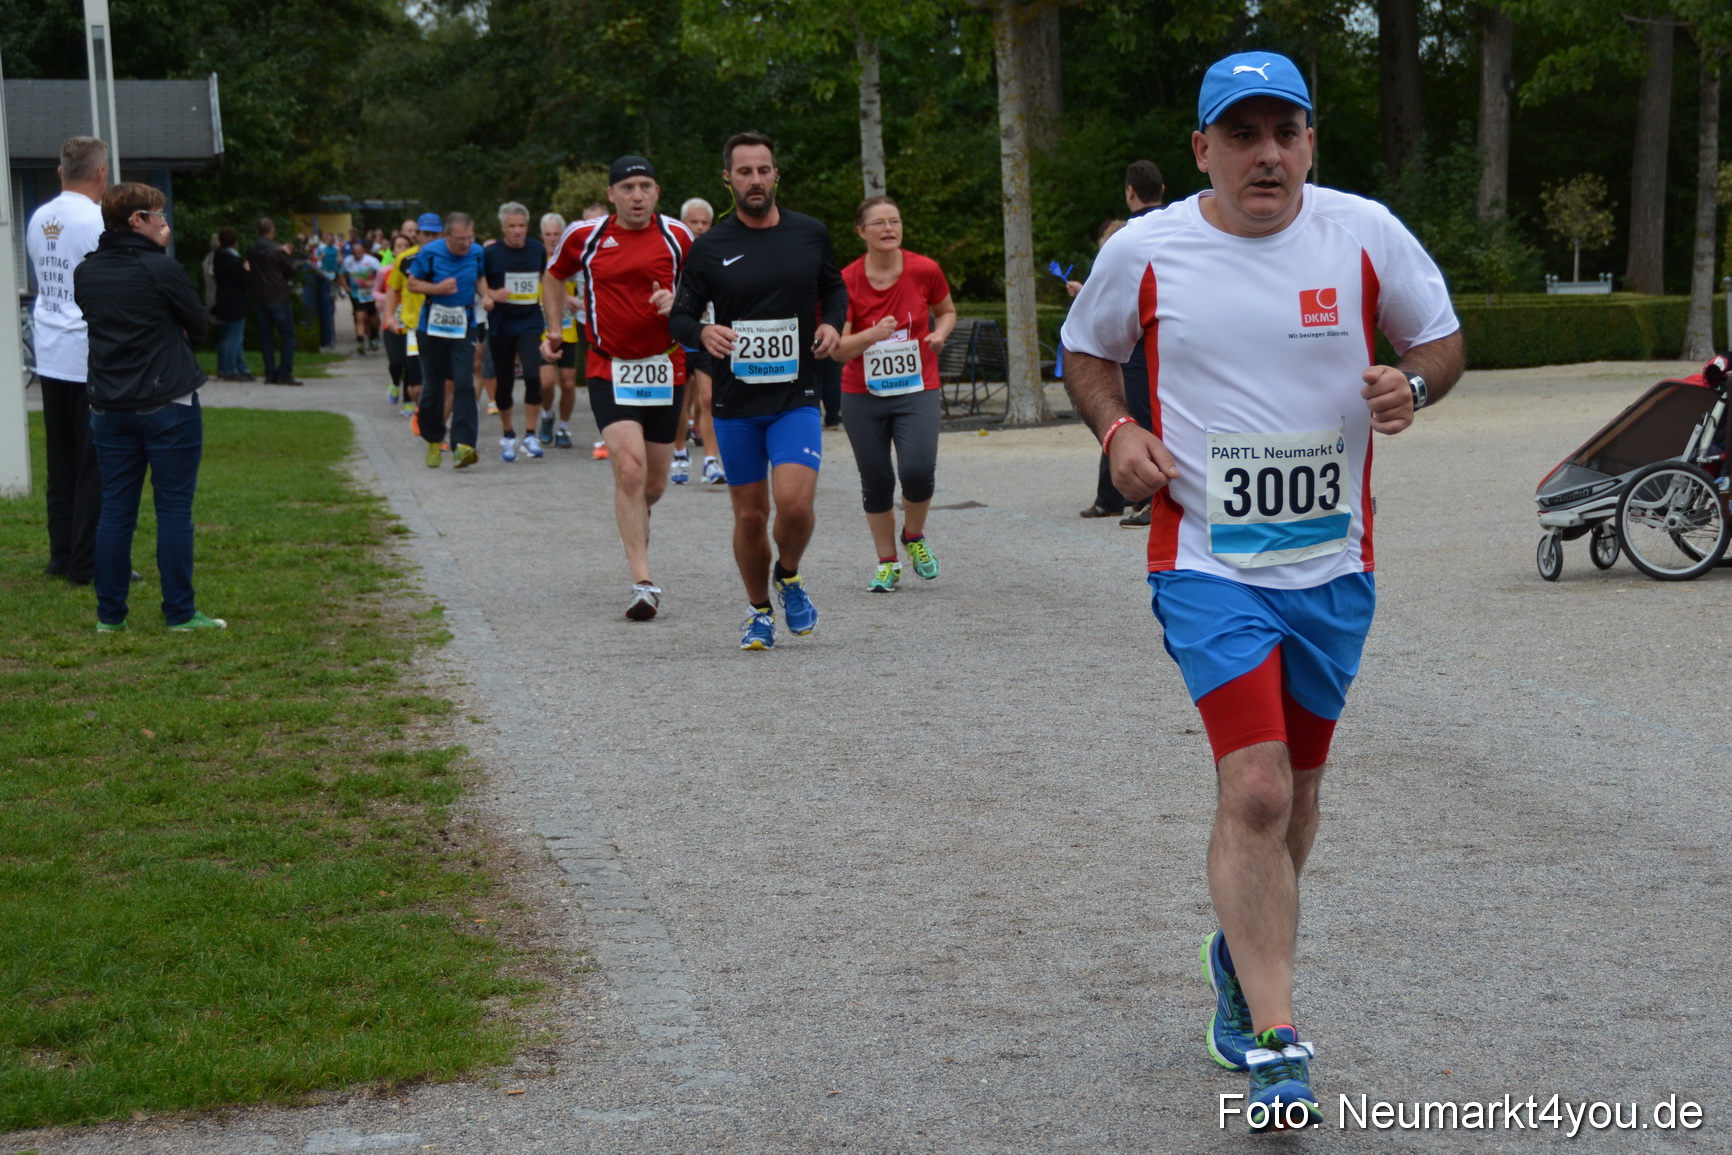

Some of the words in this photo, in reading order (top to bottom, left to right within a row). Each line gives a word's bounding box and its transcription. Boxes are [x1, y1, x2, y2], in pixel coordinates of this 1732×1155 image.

[47, 241, 56, 251] IM
[514, 281, 534, 292] 195
[1304, 312, 1336, 323] DKMS
[739, 335, 793, 359] 2380
[748, 365, 785, 375] Stephan
[870, 354, 917, 377] 2039
[620, 364, 667, 384] 2208
[881, 379, 909, 389] Claudia
[636, 389, 652, 398] Max
[1211, 446, 1260, 459] PARTL
[1264, 444, 1333, 459] Neumarkt
[1223, 462, 1341, 517] 3003
